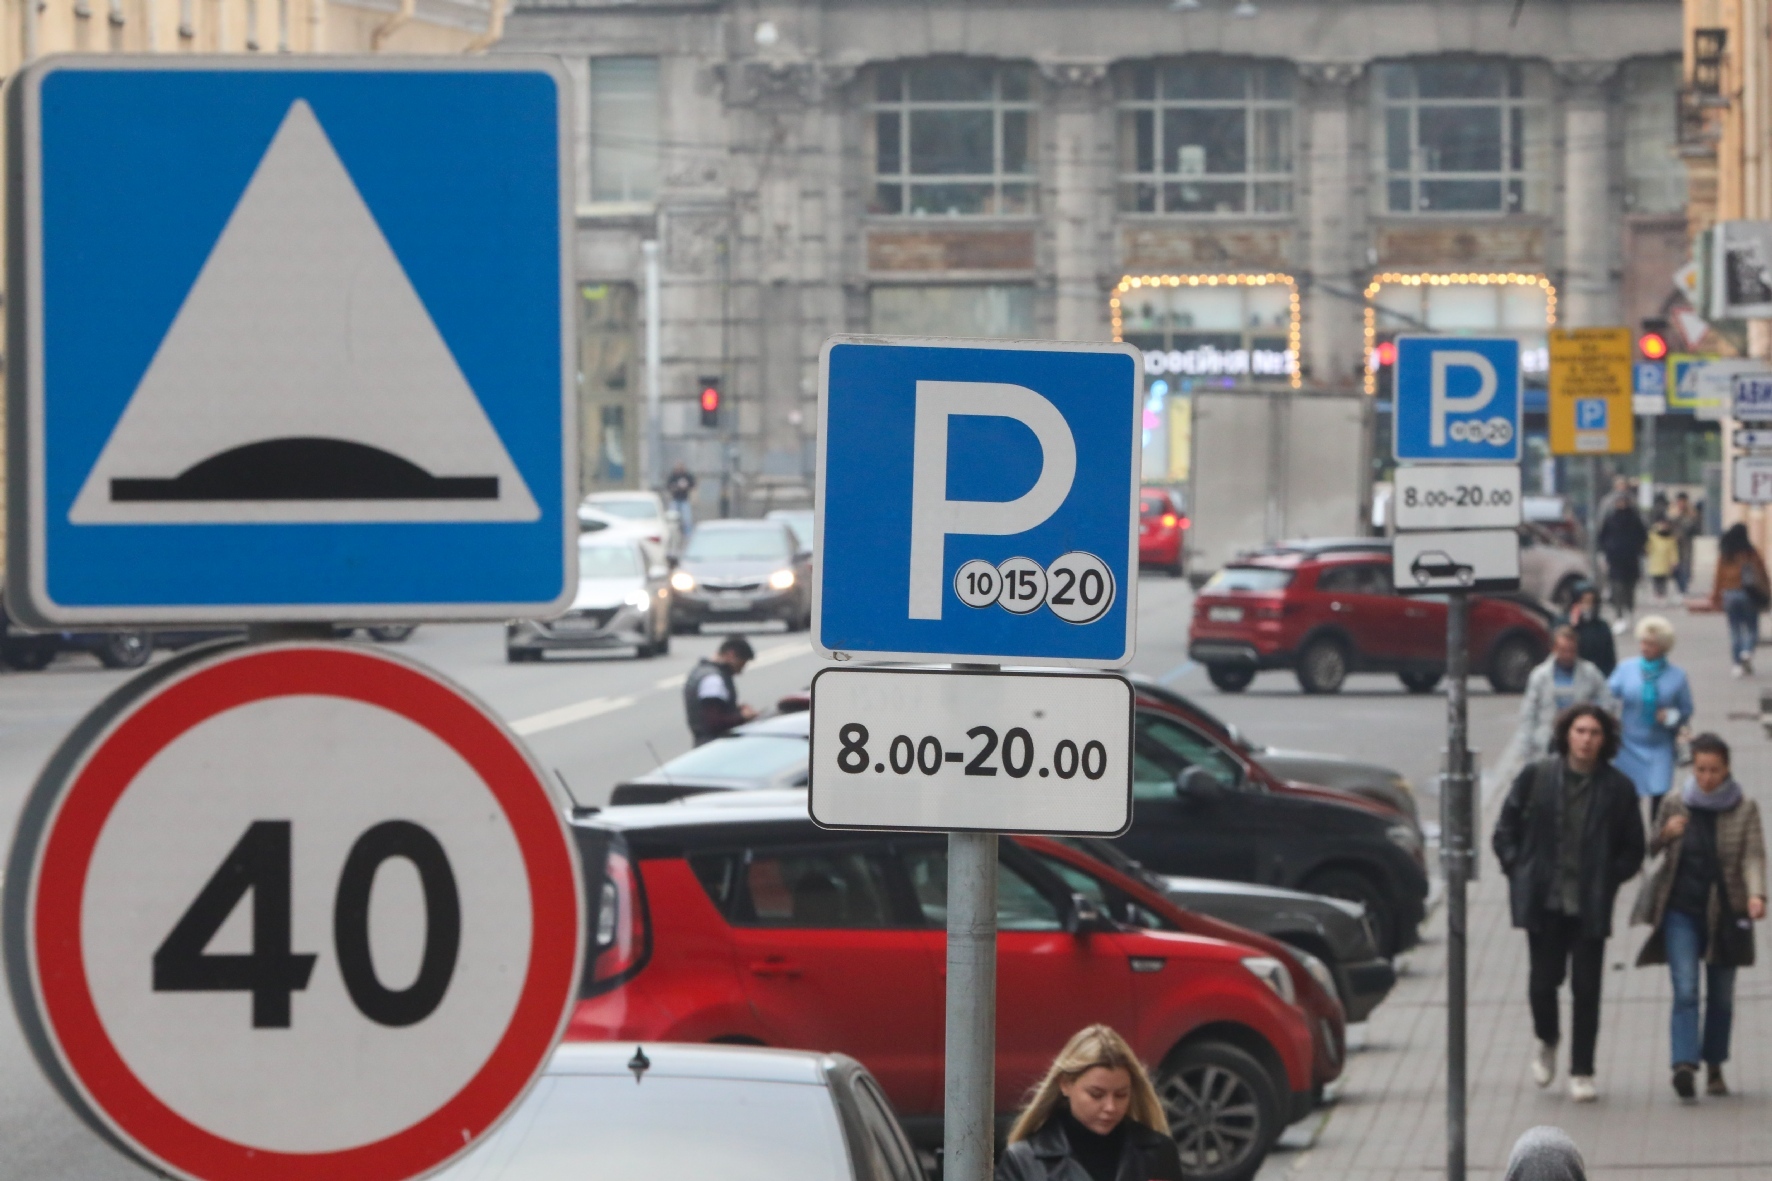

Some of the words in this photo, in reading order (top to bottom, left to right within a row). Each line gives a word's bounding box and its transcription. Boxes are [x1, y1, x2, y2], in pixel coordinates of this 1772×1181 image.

[1430, 350, 1498, 447] P
[1582, 401, 1603, 428] P
[1487, 423, 1510, 439] 20
[908, 380, 1077, 621] P
[1404, 487, 1513, 508] 8.00-20.00
[966, 572, 993, 596] 10
[1004, 569, 1038, 600] 15
[1051, 568, 1104, 606] 20
[836, 722, 1107, 780] 8.00-20.00
[152, 819, 461, 1029] 40
